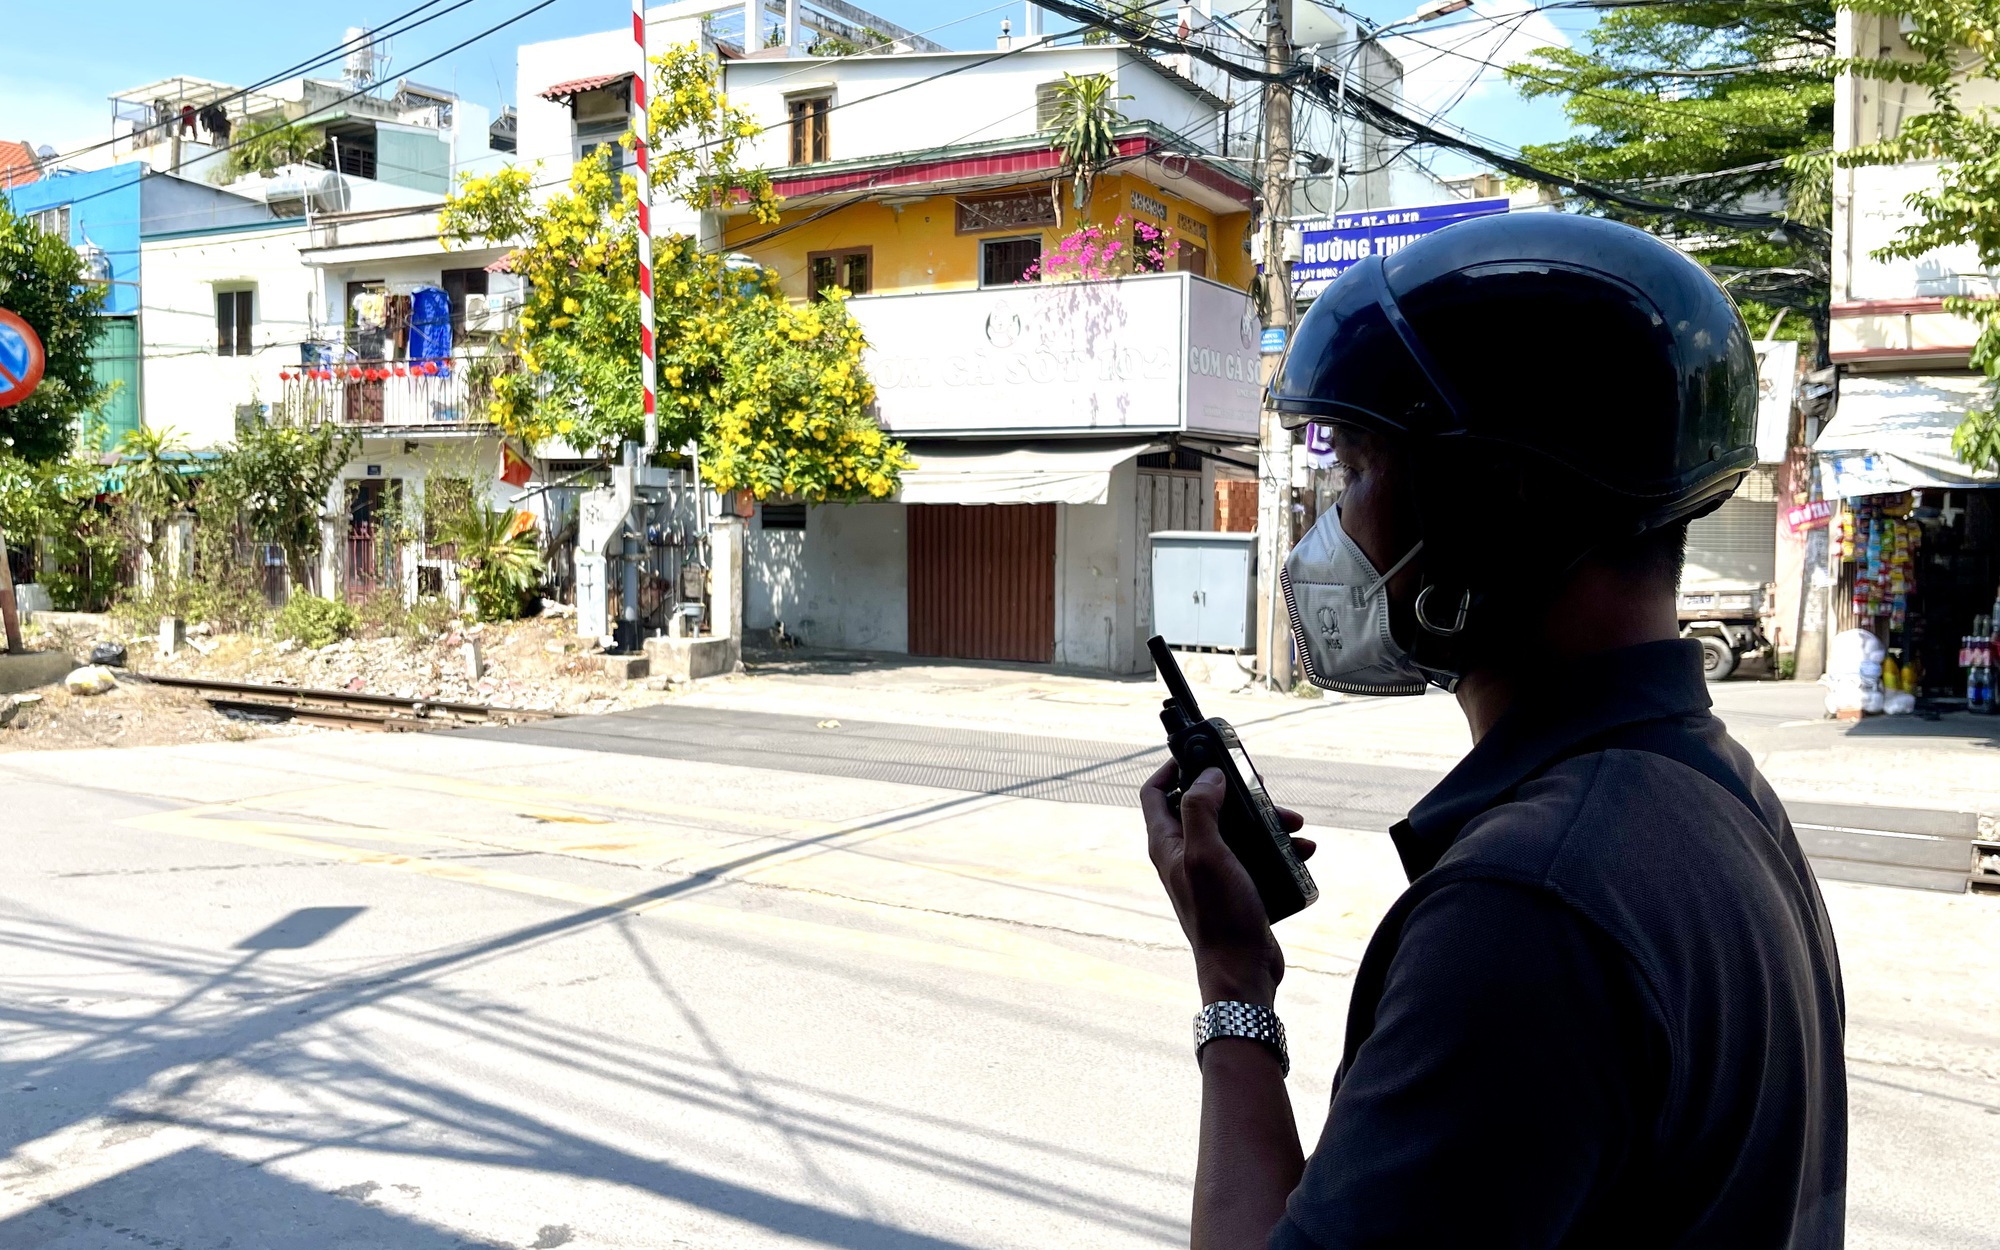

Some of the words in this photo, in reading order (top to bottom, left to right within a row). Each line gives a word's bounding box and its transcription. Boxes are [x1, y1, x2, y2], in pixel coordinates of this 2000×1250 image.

[1303, 236, 1370, 264] RƯỜNG
[866, 354, 932, 389] ƠM
[1190, 344, 1221, 378] CƠM
[1225, 348, 1244, 382] GÀ
